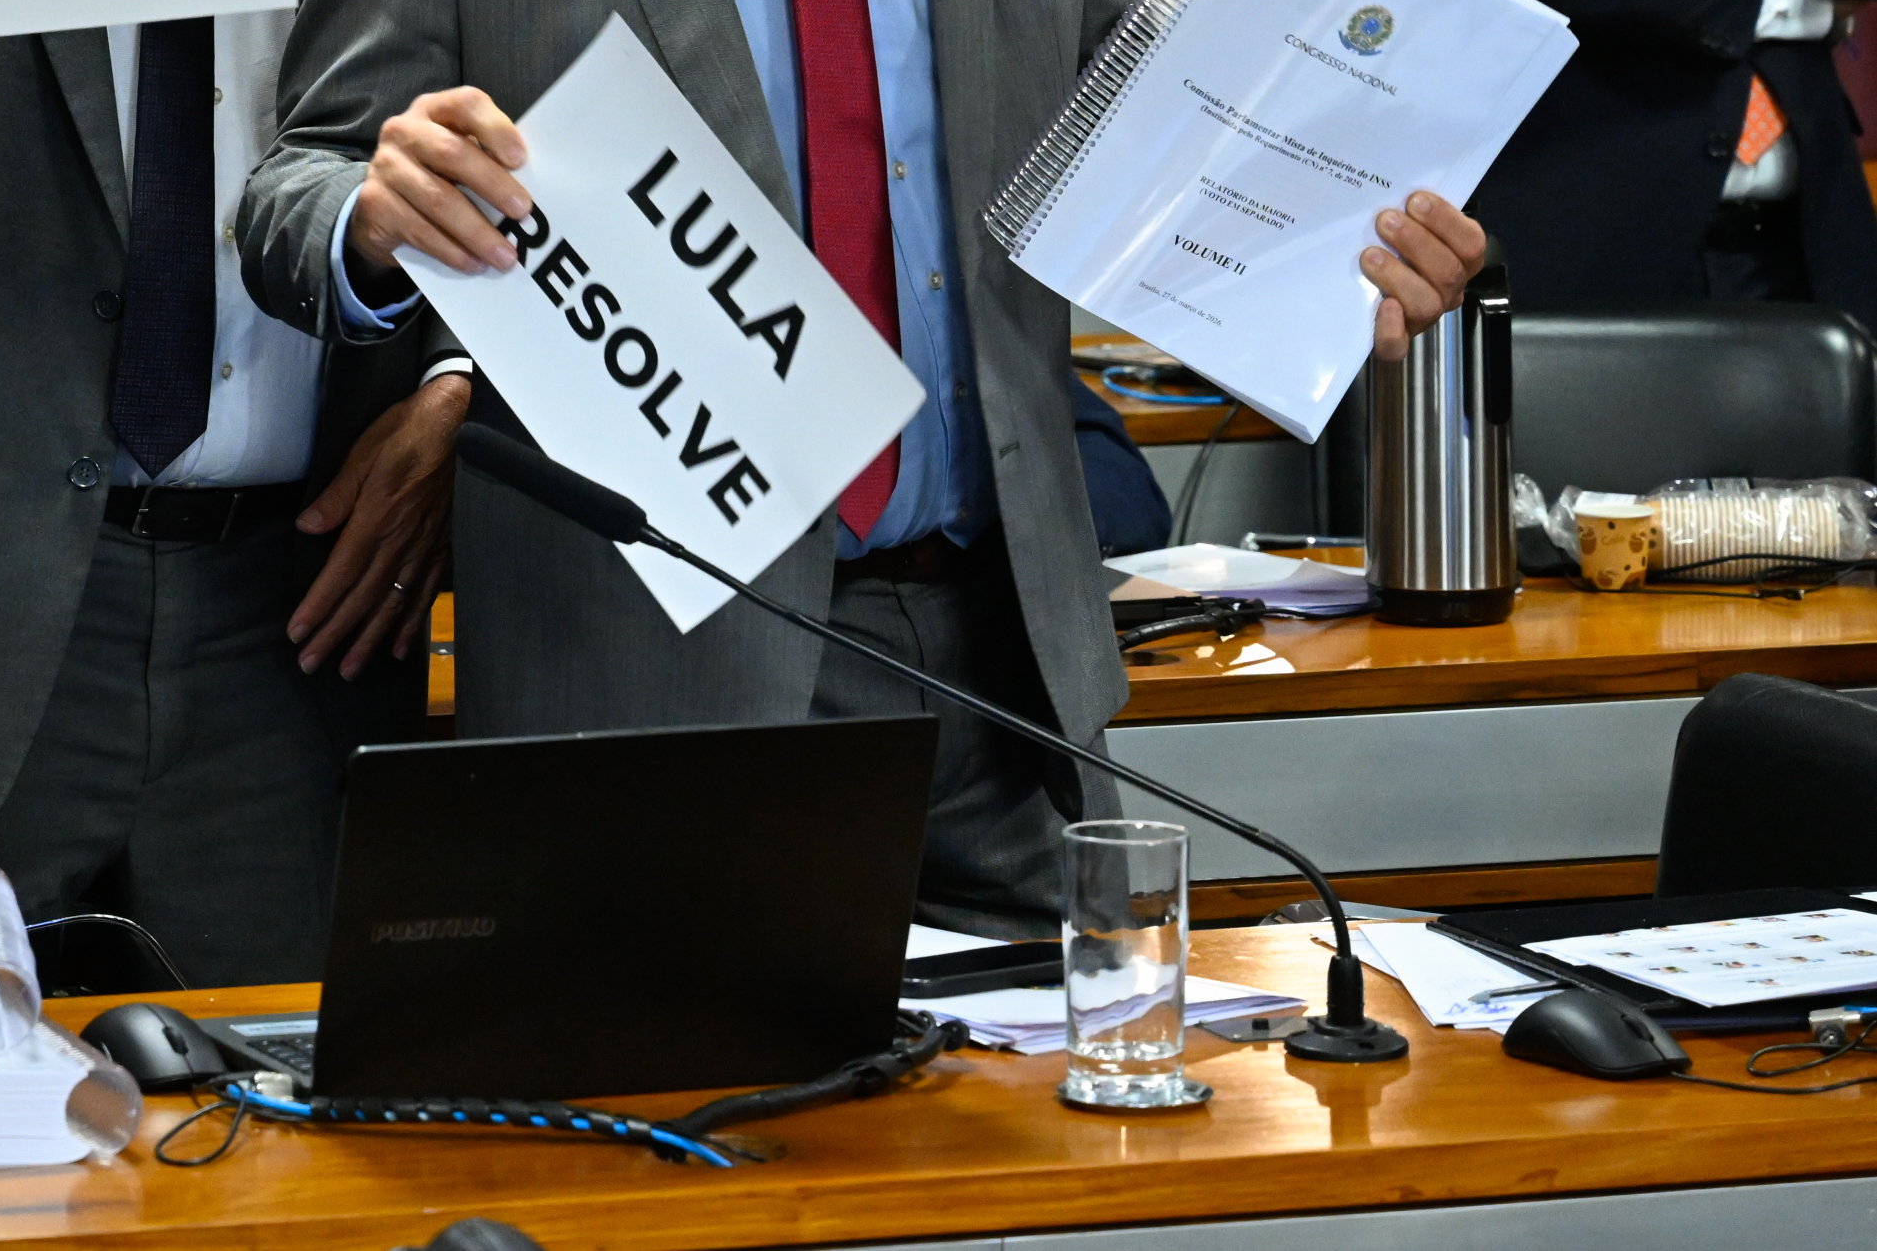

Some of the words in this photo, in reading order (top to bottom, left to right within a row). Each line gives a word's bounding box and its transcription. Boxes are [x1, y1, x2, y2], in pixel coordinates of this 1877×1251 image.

[1284, 33, 1348, 72] CONGRESSO
[1347, 67, 1398, 97] NACIONAL
[1183, 78, 1226, 110] Comissão
[1226, 105, 1282, 141] Parlamentar
[1281, 135, 1306, 152] Mista
[1307, 147, 1318, 157] de
[1318, 151, 1357, 175] Inquérito
[1357, 169, 1369, 180] do
[1368, 173, 1393, 190] INSS
[1237, 127, 1254, 140] pelo
[1254, 134, 1303, 162] Requerimento
[1301, 157, 1320, 170] (CN)
[1334, 171, 1344, 180] de
[1343, 175, 1363, 189] 2025)
[1199, 175, 1249, 204] RELATÓRIO
[1248, 198, 1260, 209] DA
[1259, 203, 1296, 225] MAIORIA
[1199, 187, 1227, 205] (VOTO
[1226, 199, 1241, 211] EM
[1240, 205, 1285, 230] SEPARADO)
[626, 146, 807, 384] LULA
[1173, 234, 1234, 269] VOLUME
[1233, 261, 1248, 276] II
[1161, 291, 1172, 299] 27
[1170, 295, 1179, 303] de
[1197, 309, 1206, 318] de
[497, 198, 772, 528] RESOLVE
